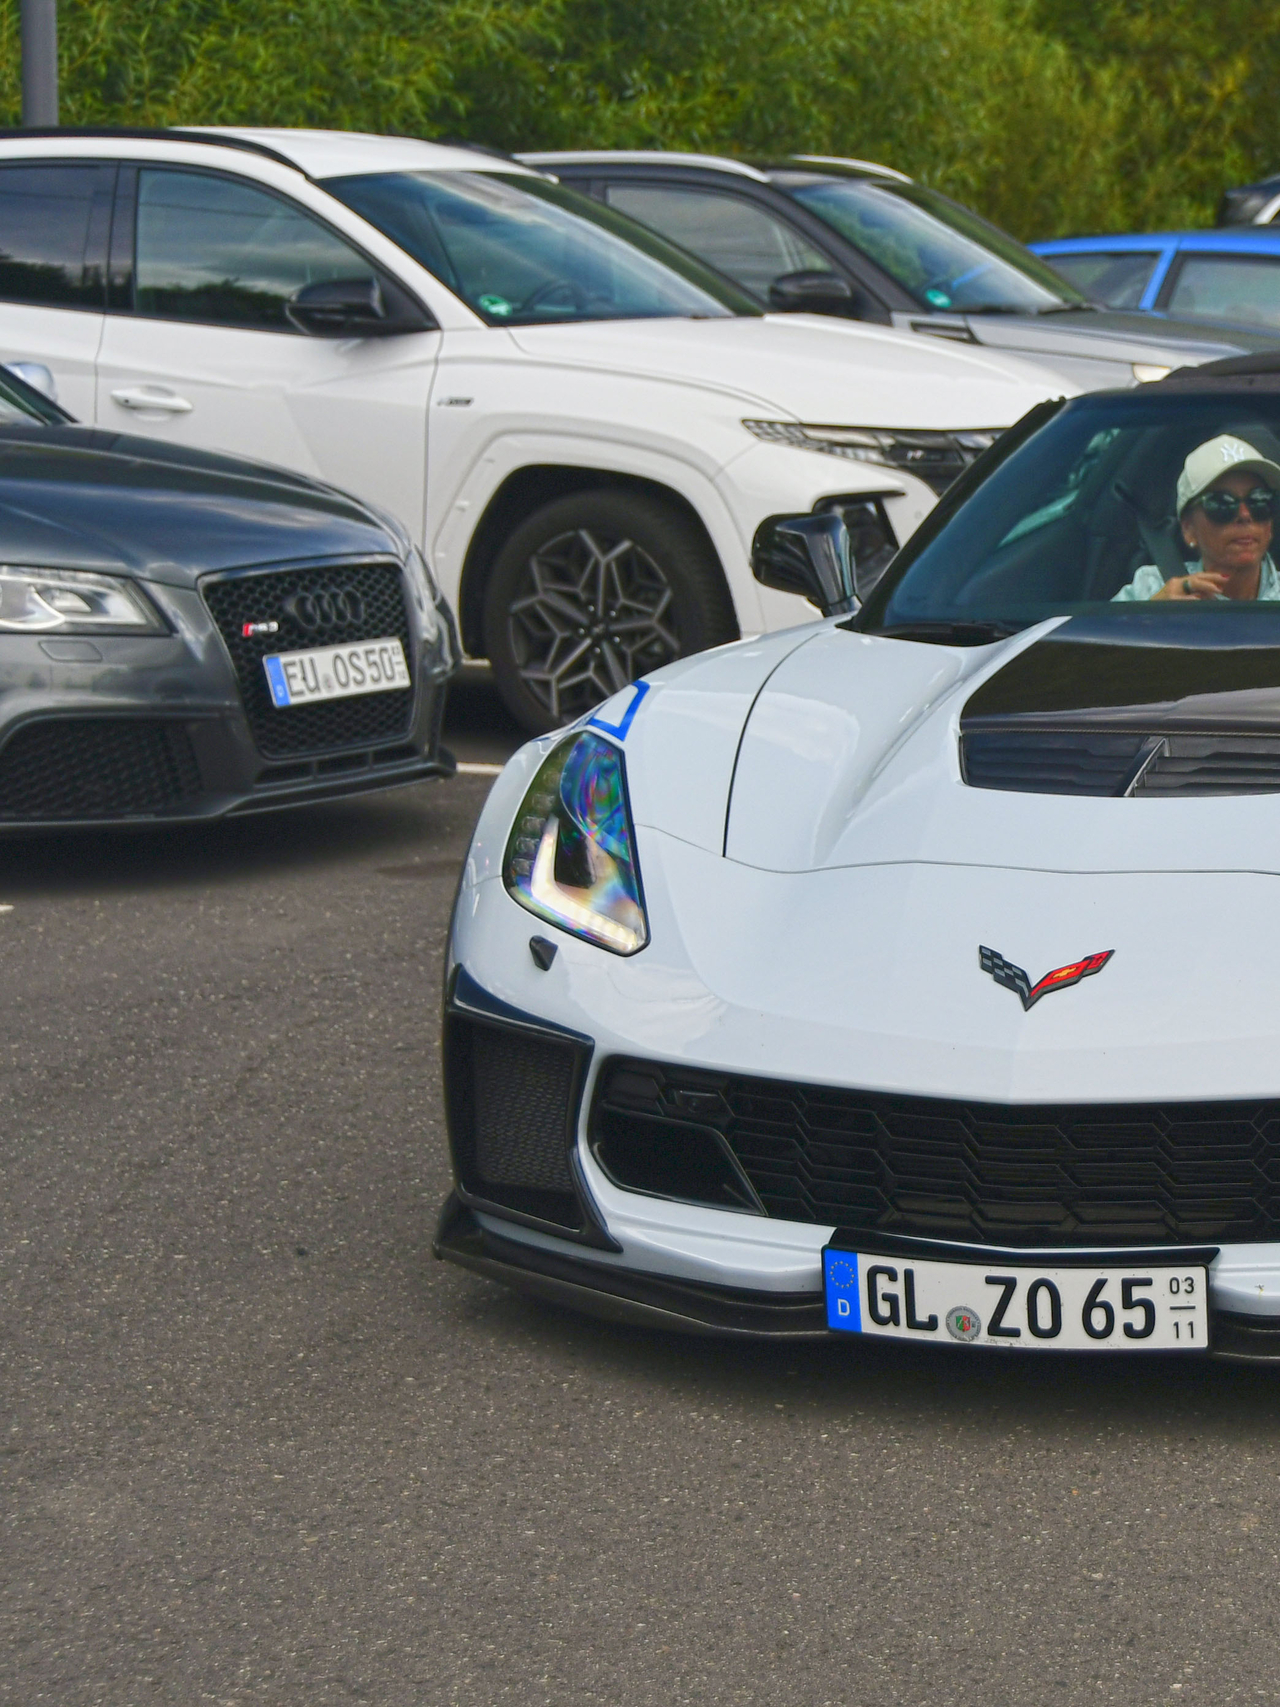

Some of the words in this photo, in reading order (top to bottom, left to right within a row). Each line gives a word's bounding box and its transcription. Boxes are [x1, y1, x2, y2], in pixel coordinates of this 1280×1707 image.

[1220, 443, 1245, 462] NY
[283, 656, 321, 697] EU
[1169, 1276, 1195, 1295] 03
[837, 1298, 851, 1317] D
[866, 1264, 939, 1332] GL
[984, 1275, 1063, 1338] ZO
[1081, 1277, 1156, 1340] 65
[1172, 1321, 1195, 1339] 11
